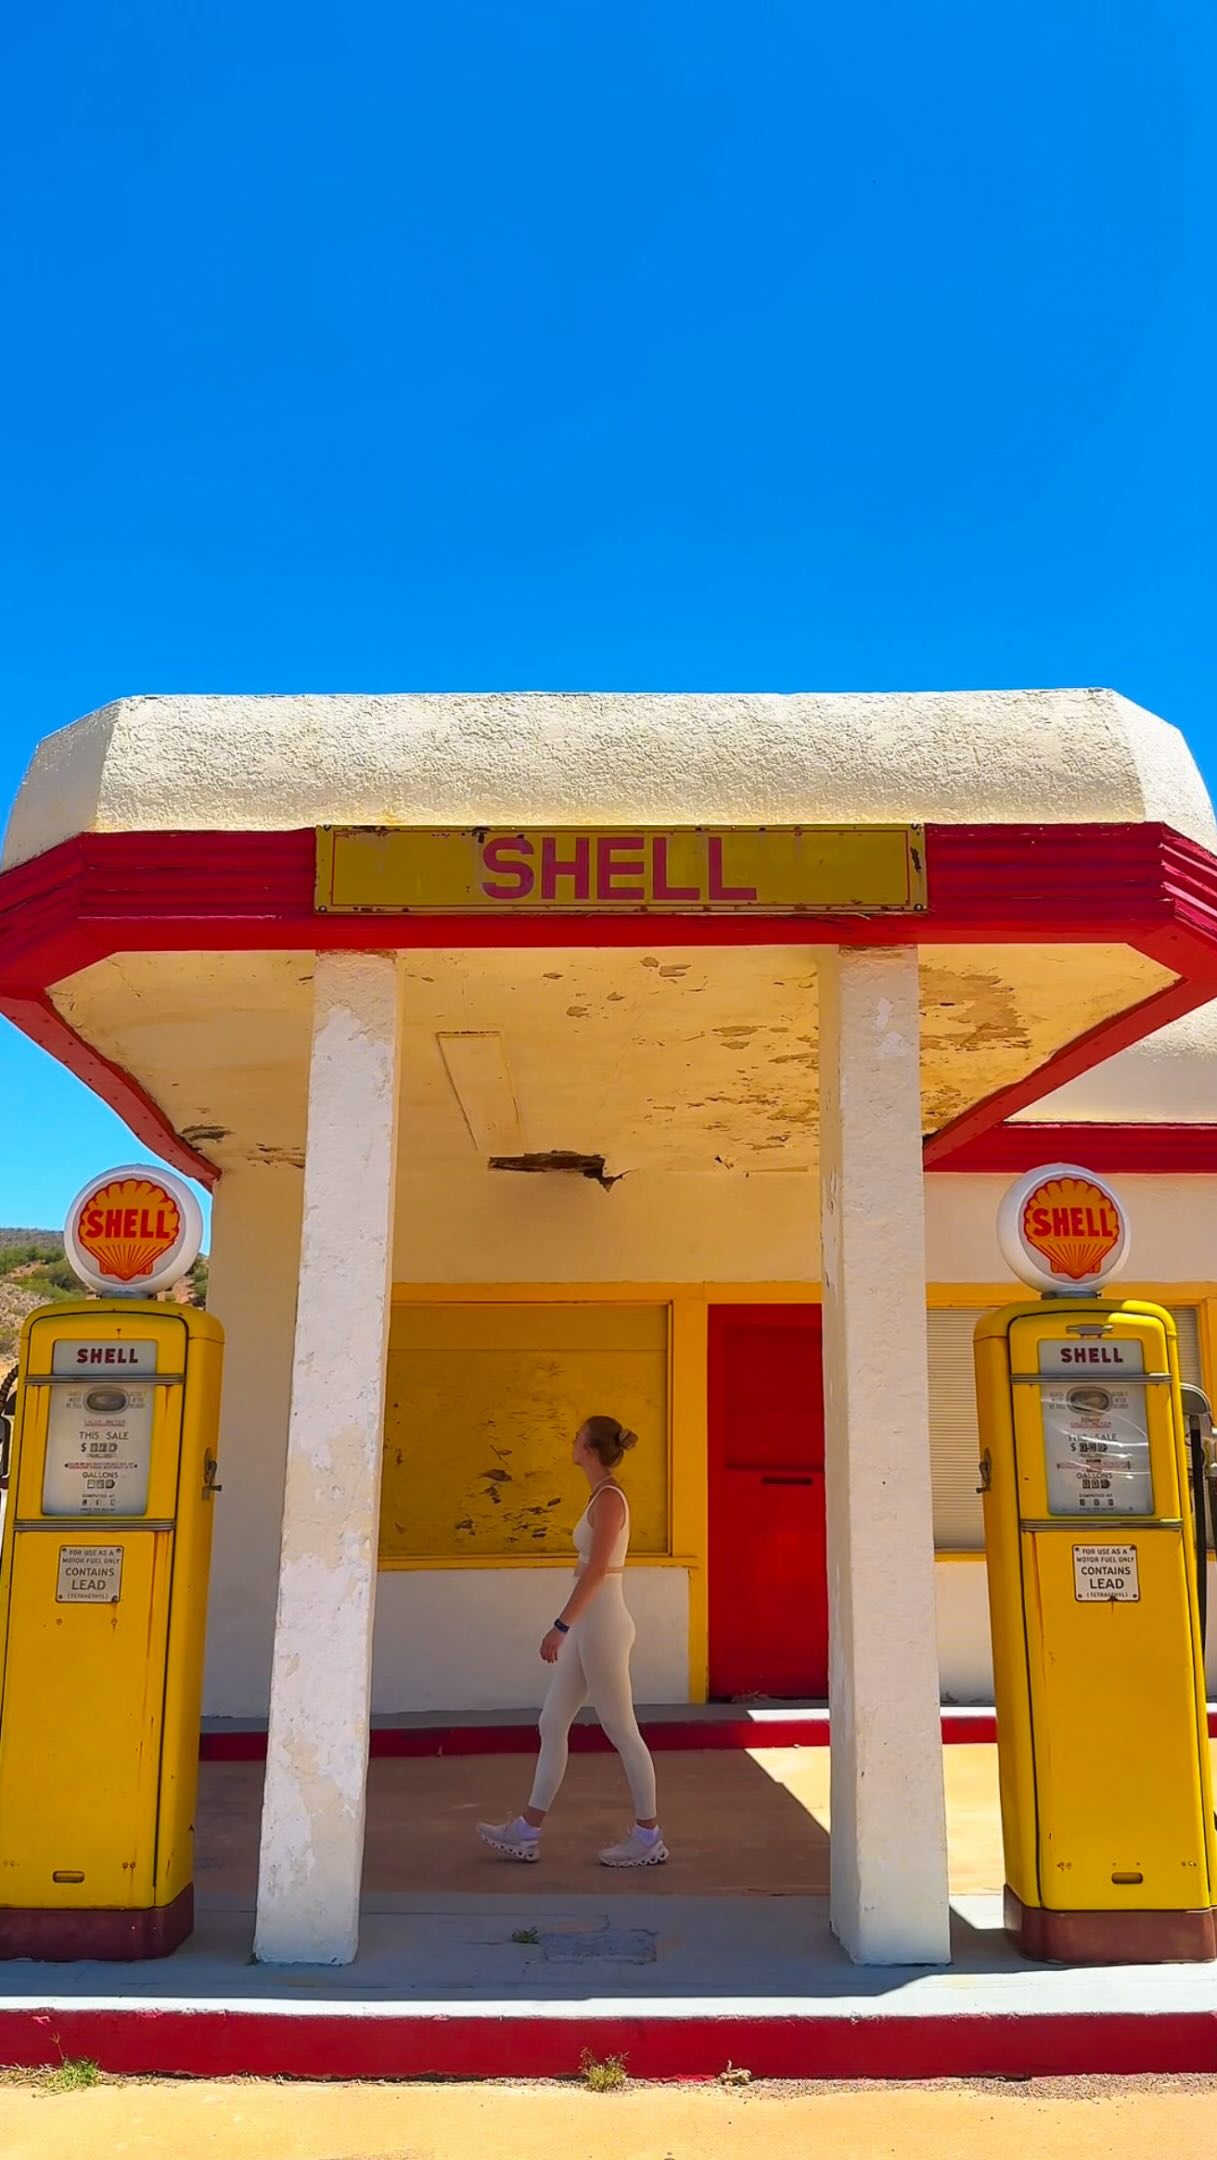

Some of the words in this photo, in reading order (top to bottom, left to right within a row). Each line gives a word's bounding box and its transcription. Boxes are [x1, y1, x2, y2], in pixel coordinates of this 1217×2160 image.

[482, 836, 757, 900] SHELL
[86, 1209, 170, 1238] SHELL
[1032, 1207, 1113, 1237] SHELL
[77, 1348, 138, 1364] SHELL
[1060, 1348, 1123, 1363] SHELL
[79, 1431, 99, 1440] THIS
[106, 1431, 128, 1440] SALE
[1095, 1433, 1118, 1441] SALE
[65, 1567, 114, 1576] CONTAINS
[1081, 1566, 1131, 1575] CONTAINS
[72, 1579, 106, 1590] LEAD
[1089, 1578, 1124, 1589] LEAD
